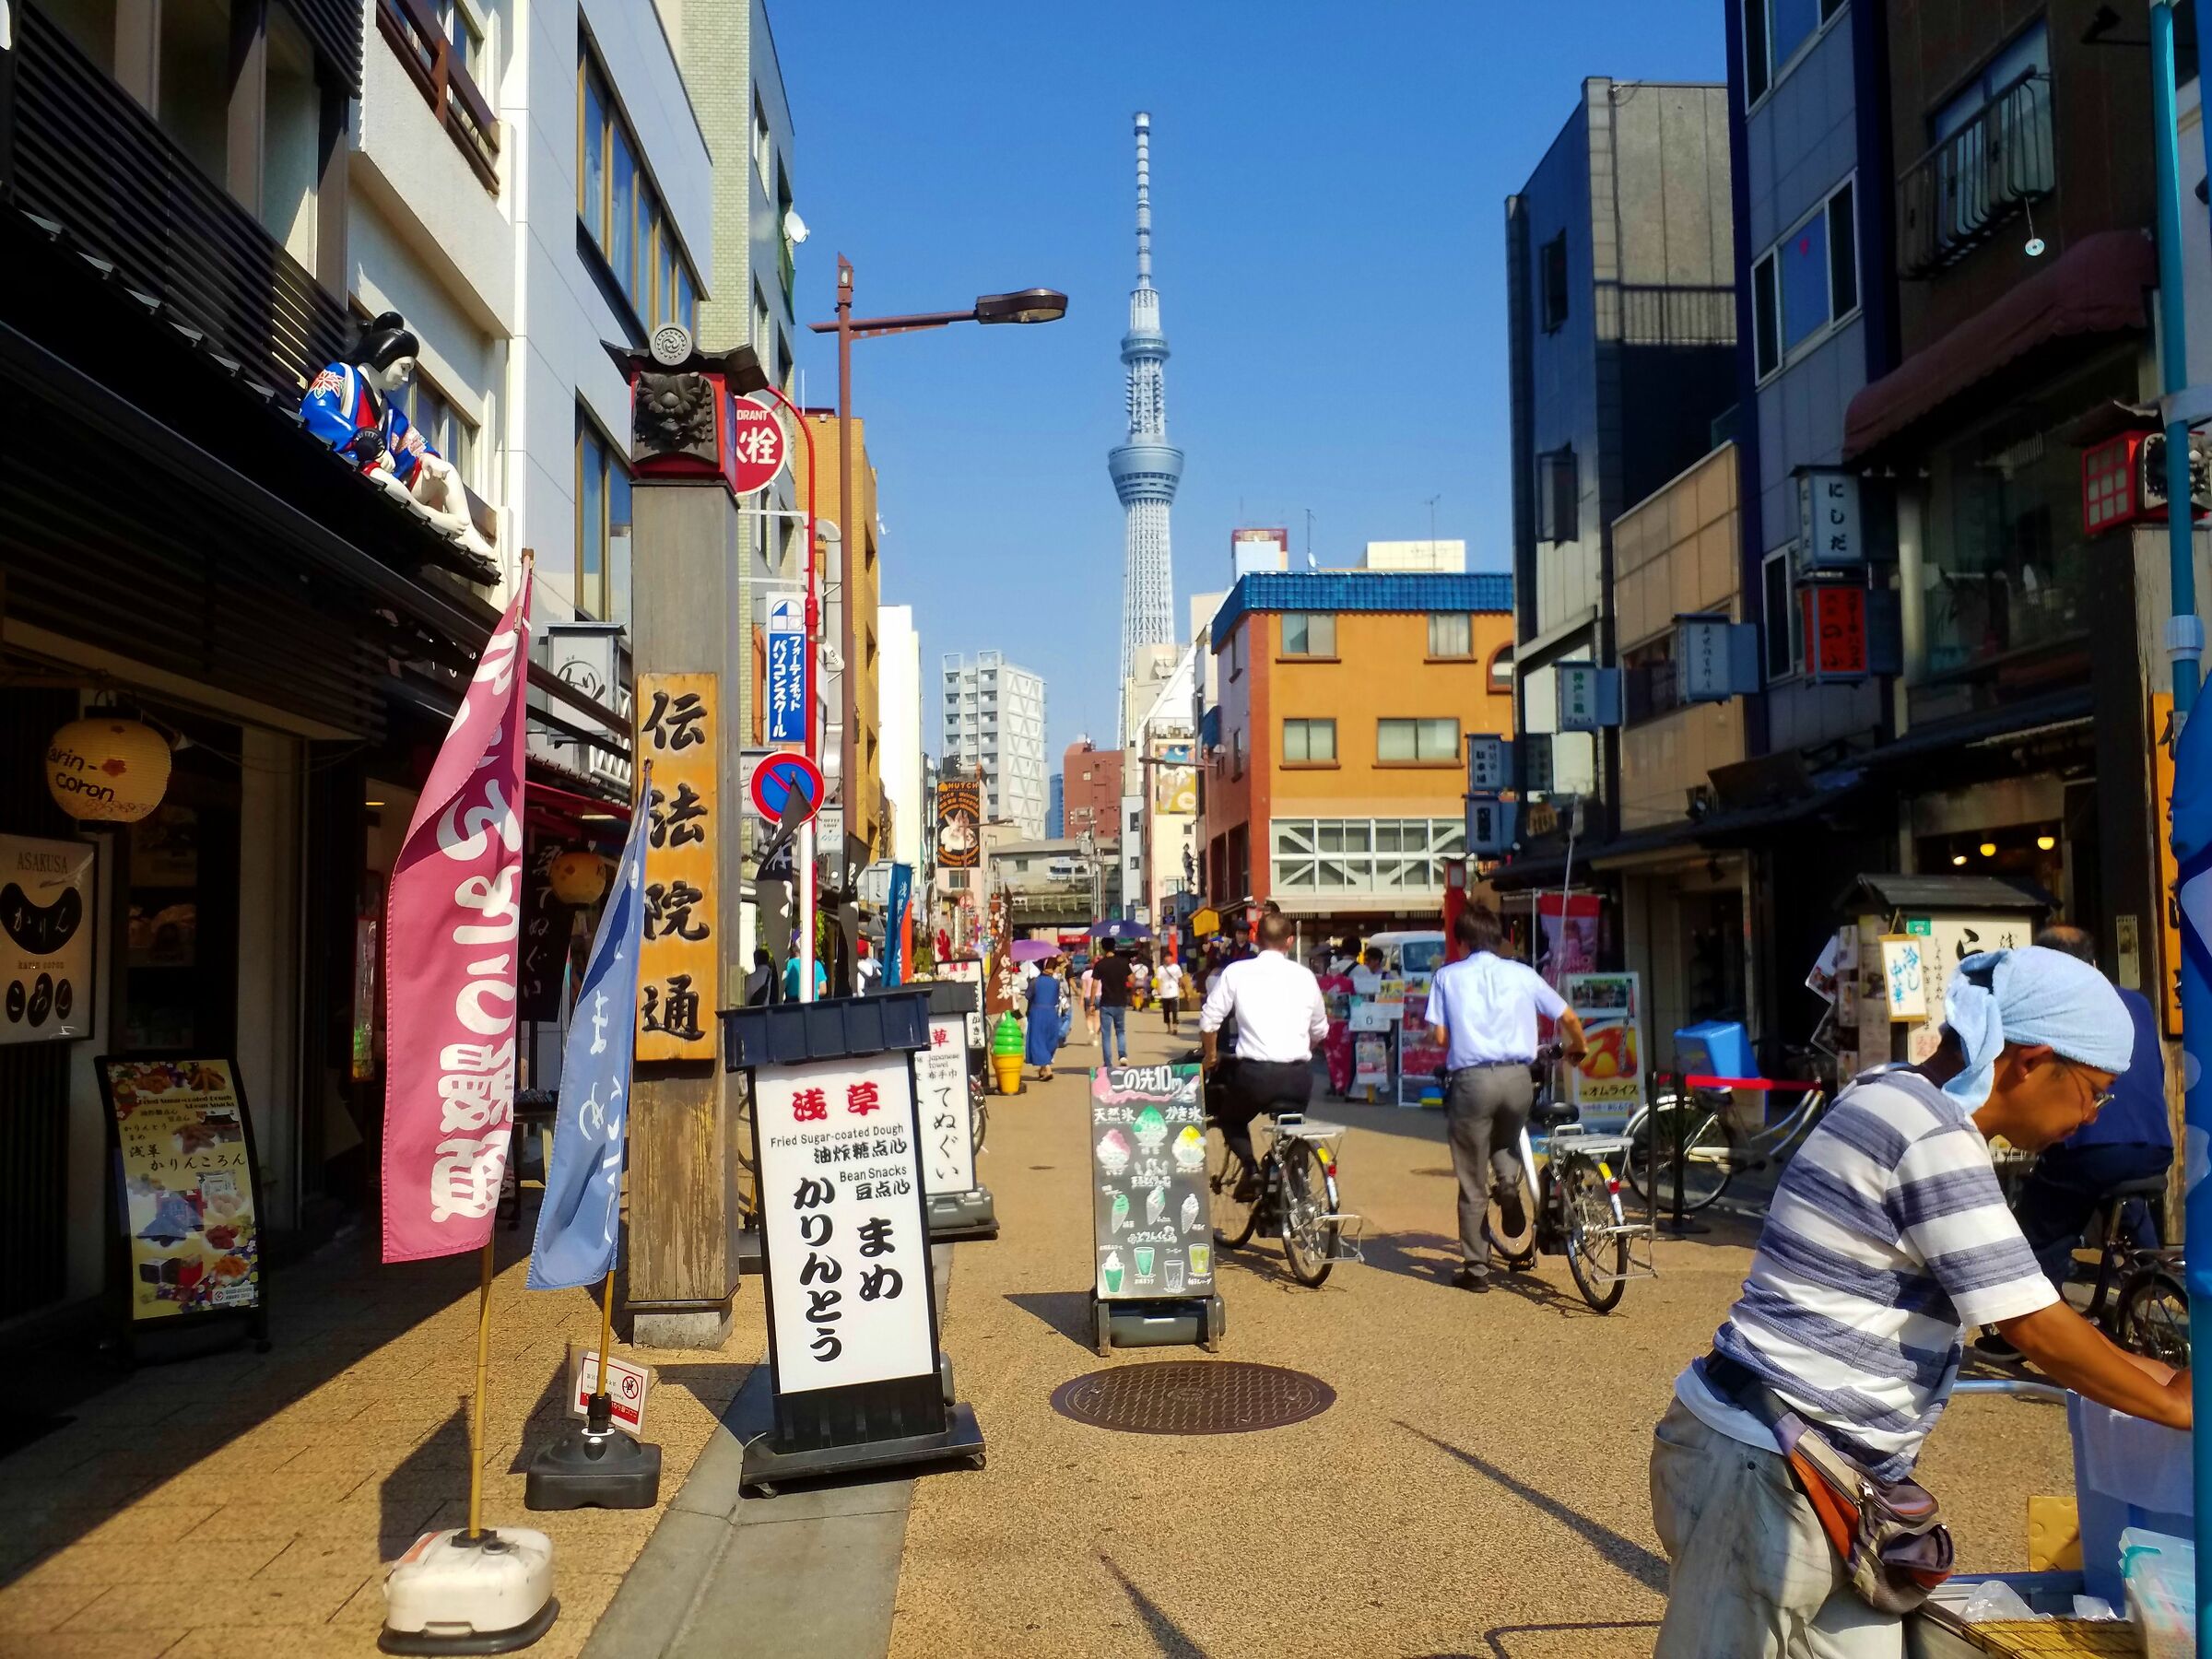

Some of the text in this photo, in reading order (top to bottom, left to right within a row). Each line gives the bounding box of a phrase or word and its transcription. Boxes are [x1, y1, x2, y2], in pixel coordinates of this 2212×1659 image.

[737, 409, 769, 422] DRANT
[1828, 482, 1847, 551] にしだ
[789, 635, 802, 712] フォーティネット
[772, 639, 787, 738] パソコンスクール
[48, 748, 98, 771] arin-
[55, 772, 114, 802] coron
[17, 852, 68, 874] ASAKUSA
[641, 691, 711, 1042] 伝法院通
[792, 1081, 880, 1122] 浅草
[1589, 1084, 1639, 1097] オムライス
[1094, 1107, 1136, 1122] 天然氷
[1164, 1106, 1204, 1122] かき氷
[771, 1123, 904, 1147] Fried Sugar-coated Dough
[933, 1086, 959, 1180] てぬぐい
[129, 1144, 160, 1158] 浅草
[150, 1153, 245, 1171] かりんころん
[814, 1138, 907, 1164] 油炸糖点心
[840, 1165, 907, 1182] Bean Snacks
[855, 1179, 911, 1201] 豆点心
[793, 1175, 843, 1363] かりんとう
[856, 1217, 903, 1302] まめ
